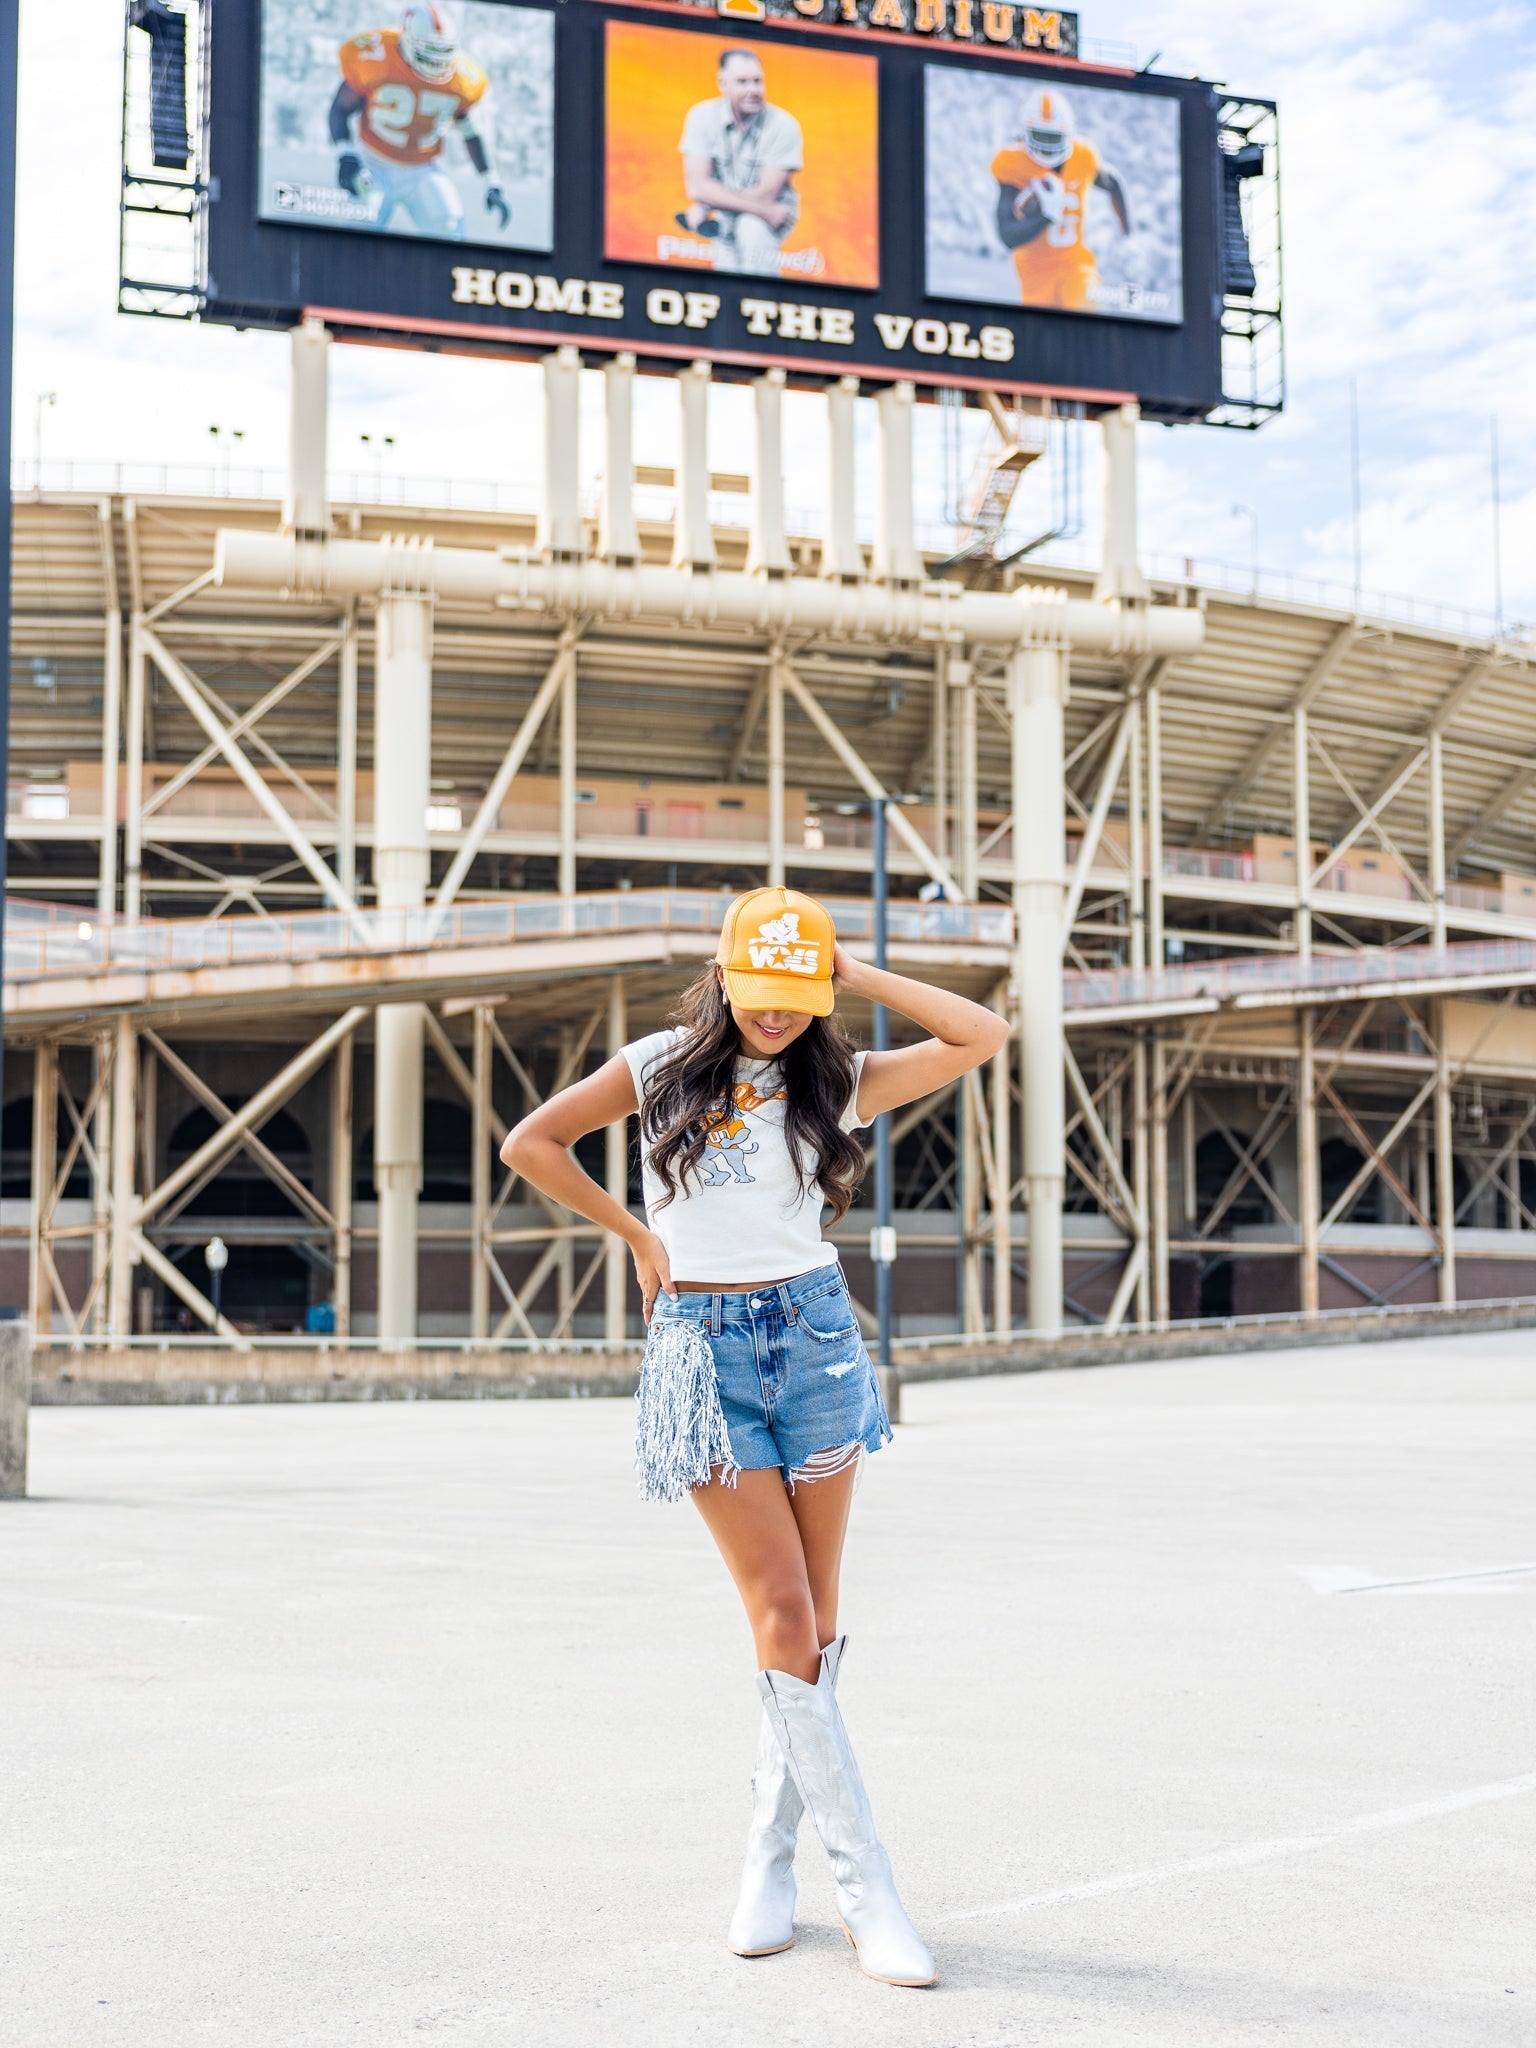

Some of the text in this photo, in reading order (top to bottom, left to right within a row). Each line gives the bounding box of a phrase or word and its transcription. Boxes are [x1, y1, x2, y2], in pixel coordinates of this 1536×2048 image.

[368, 83, 461, 148] 27
[452, 266, 1015, 362] HOME OF THE VOLS
[748, 945, 819, 975] VOLS
